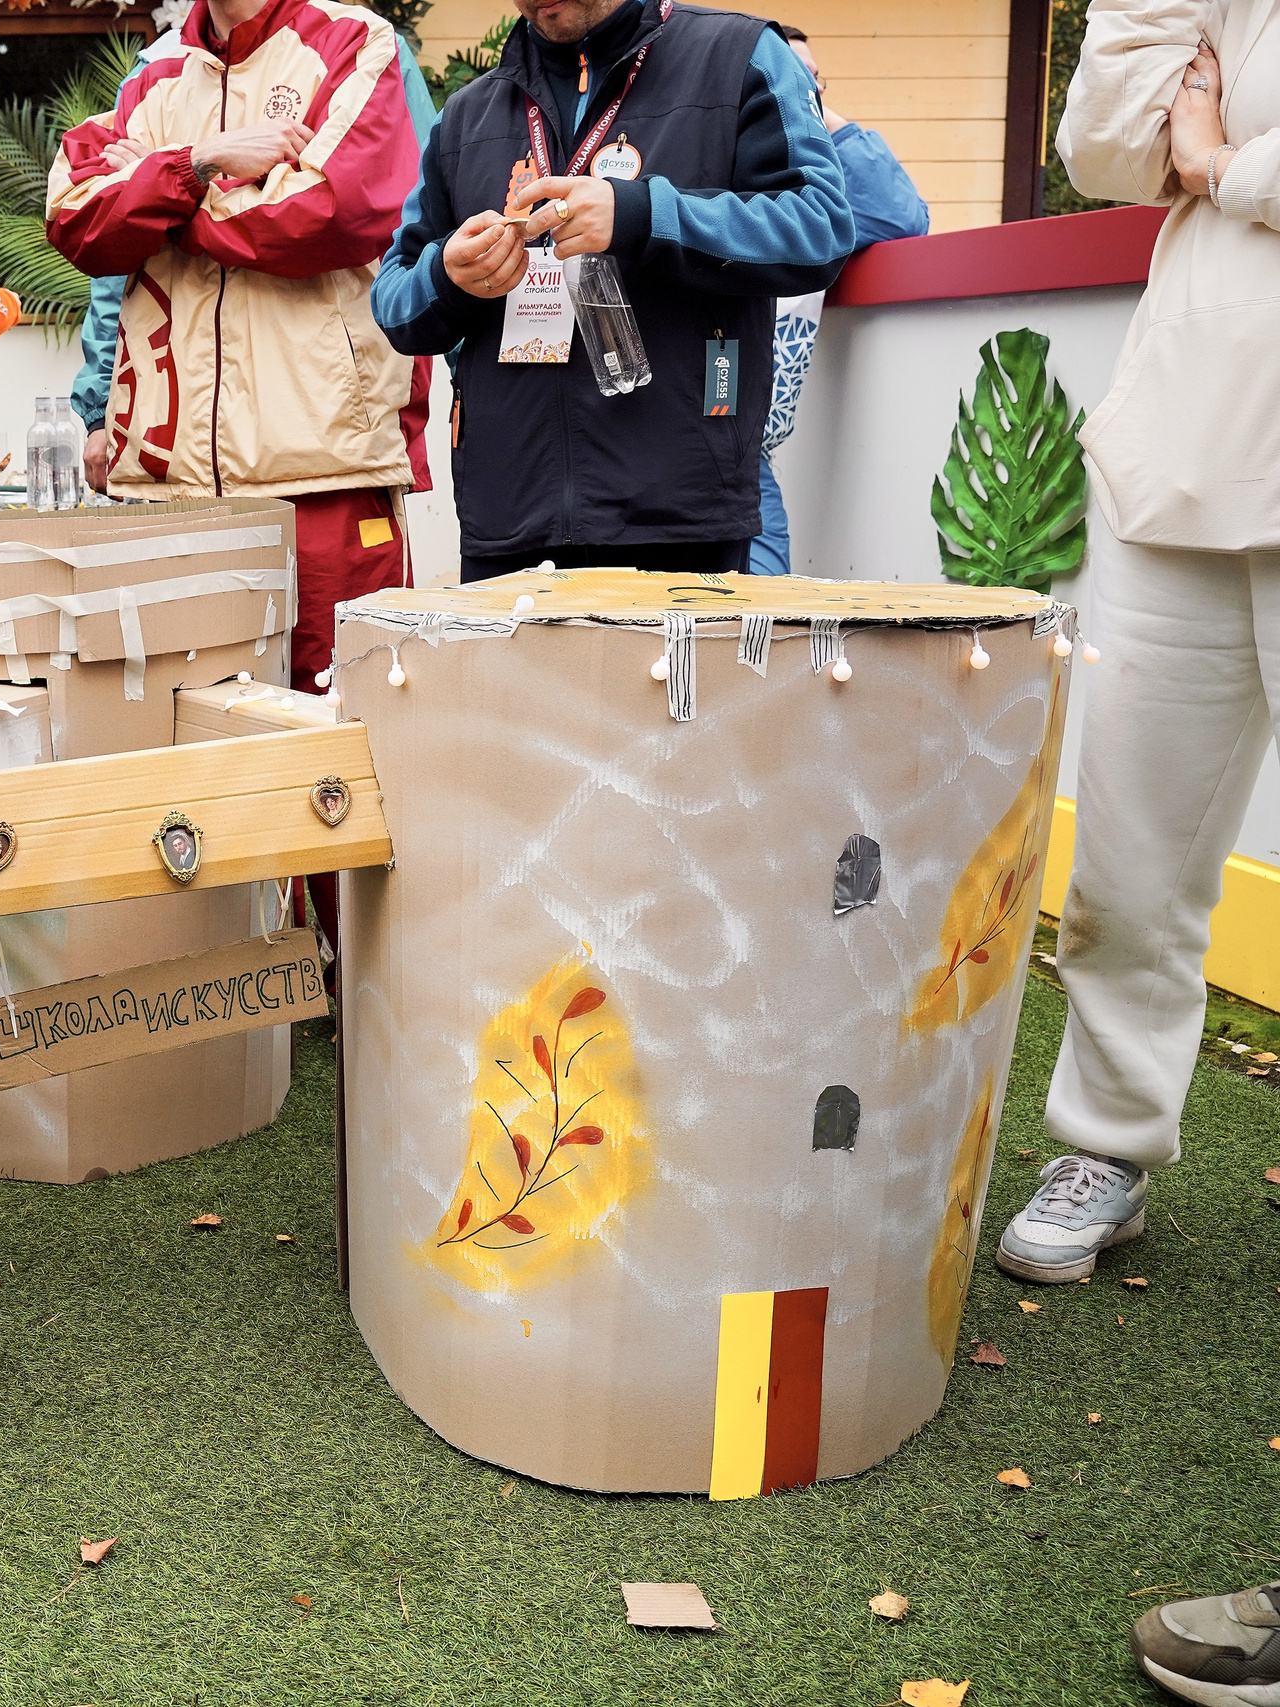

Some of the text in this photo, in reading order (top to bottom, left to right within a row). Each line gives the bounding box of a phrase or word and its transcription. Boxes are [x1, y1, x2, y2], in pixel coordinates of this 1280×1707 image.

[272, 101, 287, 111] 95
[533, 125, 547, 169] ФУНДАМЕНТ
[526, 271, 562, 287] XVIII
[141, 957, 322, 1033] ИСКУССТВ
